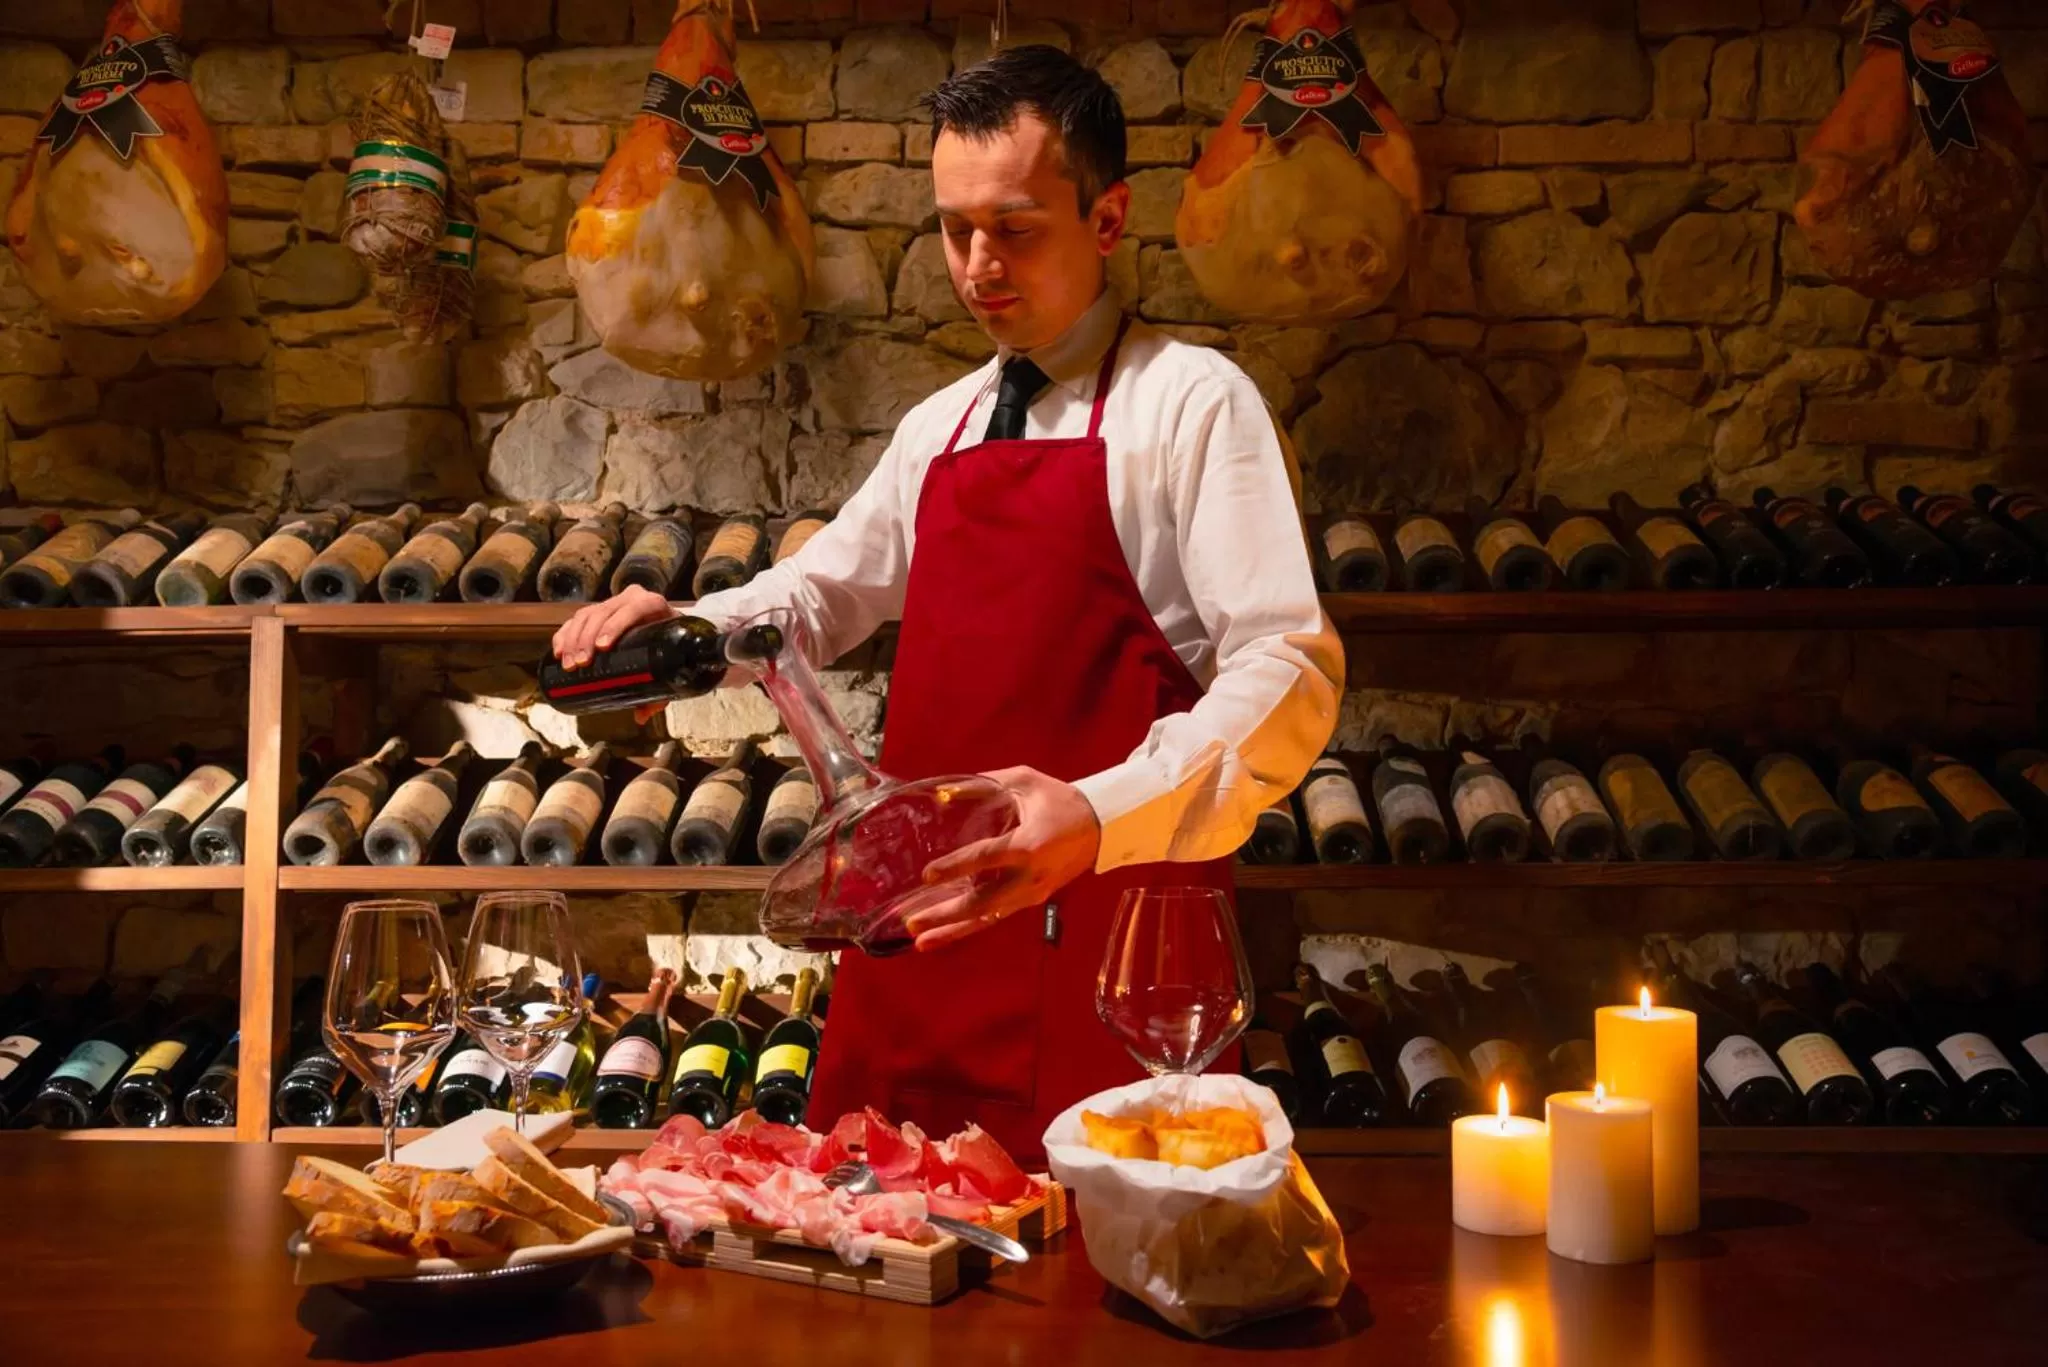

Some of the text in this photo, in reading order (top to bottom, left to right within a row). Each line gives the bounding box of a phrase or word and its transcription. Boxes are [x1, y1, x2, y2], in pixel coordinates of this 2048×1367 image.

[1274, 55, 1346, 71] PROSCIUTTO
[1283, 66, 1339, 77] DI PARMA
[690, 103, 754, 119] PROSCIUTTO
[702, 112, 752, 127] DI PARMA
